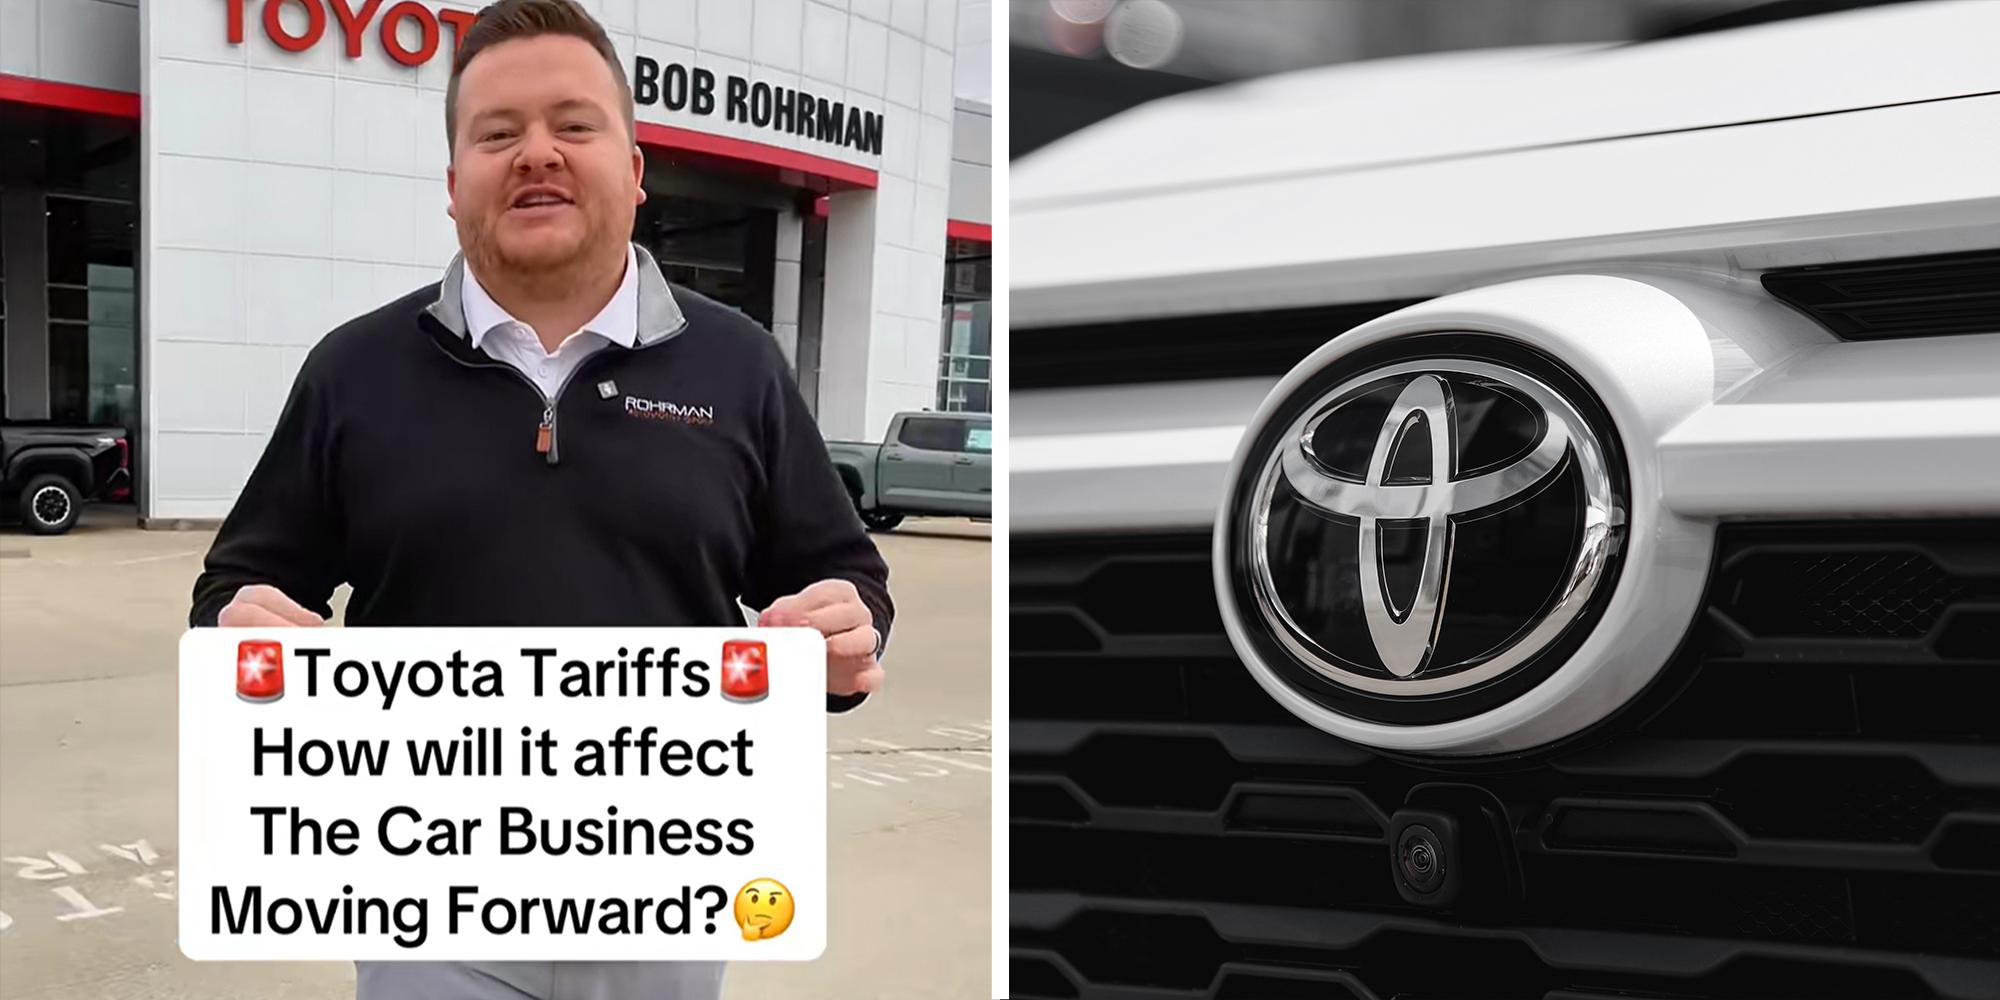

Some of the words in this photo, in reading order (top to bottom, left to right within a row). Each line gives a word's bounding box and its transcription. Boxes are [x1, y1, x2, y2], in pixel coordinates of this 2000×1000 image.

[221, 0, 479, 75] TOYOT
[634, 55, 715, 116] BOB
[726, 75, 884, 156] ROHRMAN
[625, 396, 714, 419] ROHRMAN
